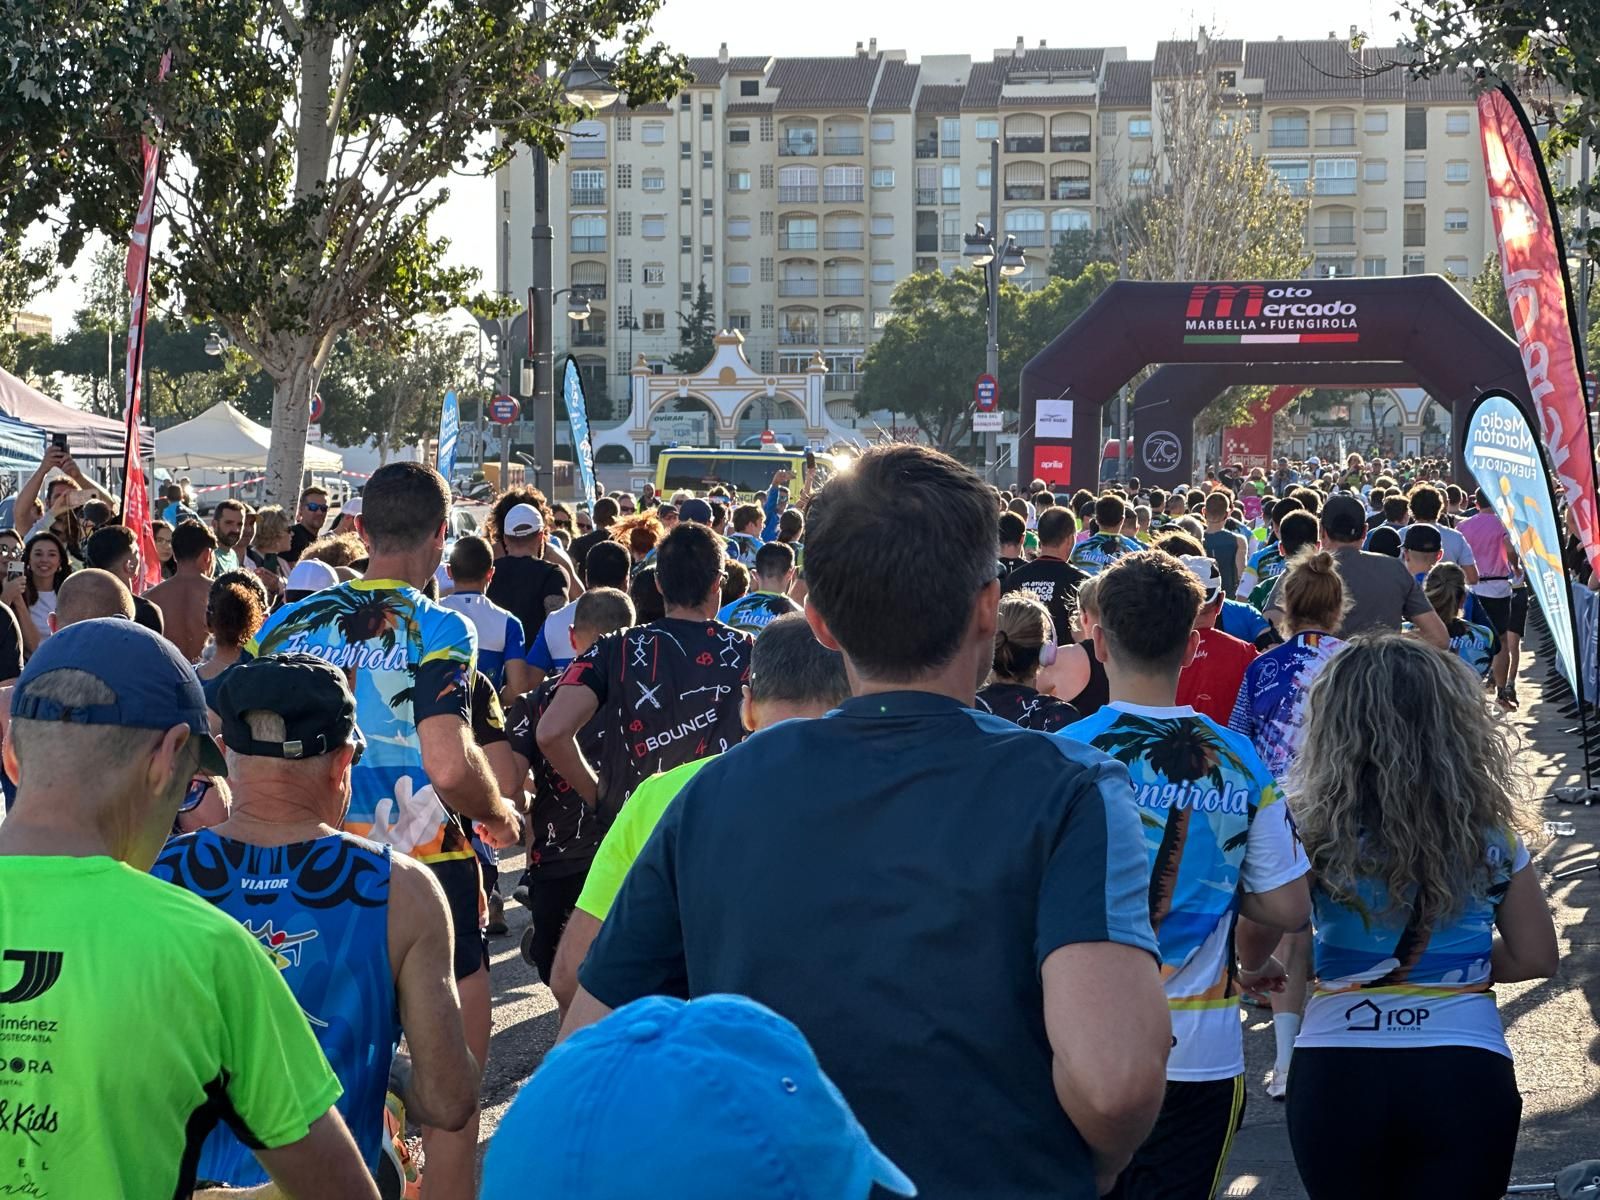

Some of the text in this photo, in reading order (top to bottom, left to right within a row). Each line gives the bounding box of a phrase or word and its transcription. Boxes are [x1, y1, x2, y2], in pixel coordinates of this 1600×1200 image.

[1185, 317, 1358, 331] MARBELLA FUENGIROLA
[241, 877, 289, 890] VIATOR
[0, 1013, 59, 1033] iménez
